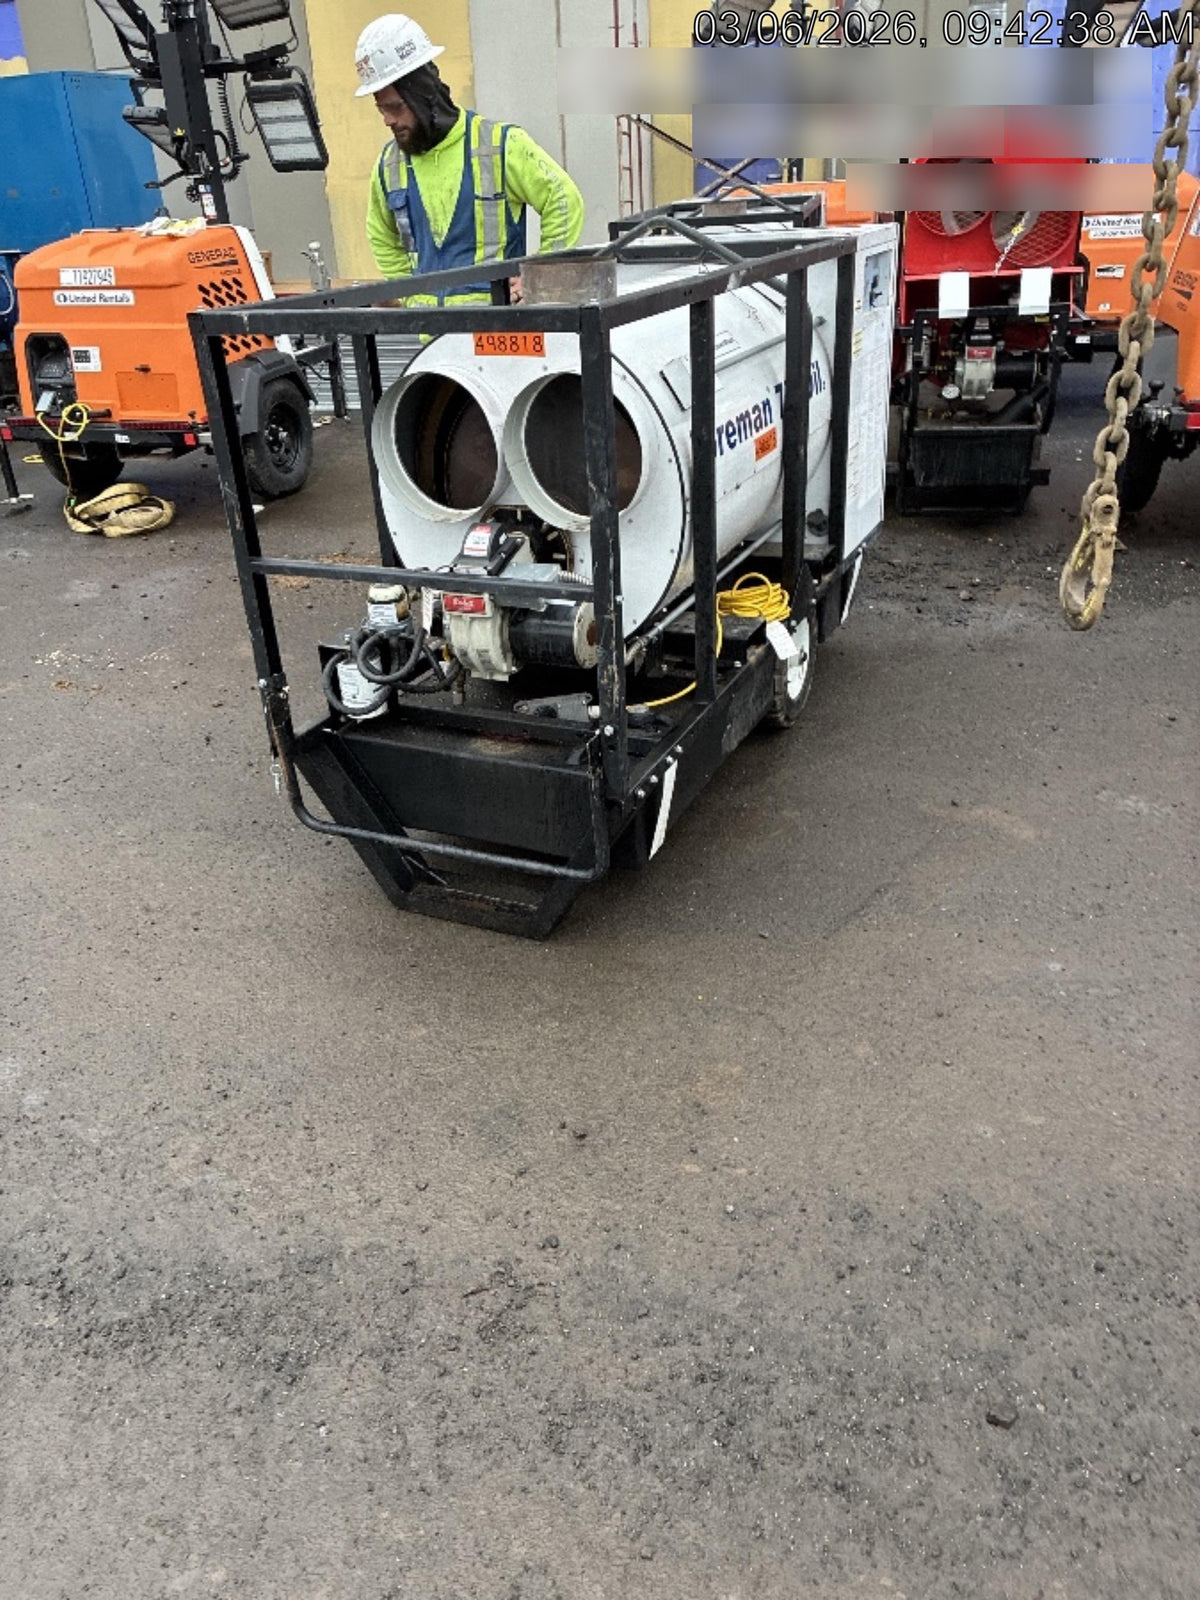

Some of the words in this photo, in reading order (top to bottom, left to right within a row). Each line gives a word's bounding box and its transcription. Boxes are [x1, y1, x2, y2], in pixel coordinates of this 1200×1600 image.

[69, 292, 97, 304] United
[99, 292, 131, 304] Rentals
[475, 335, 544, 353] 498818
